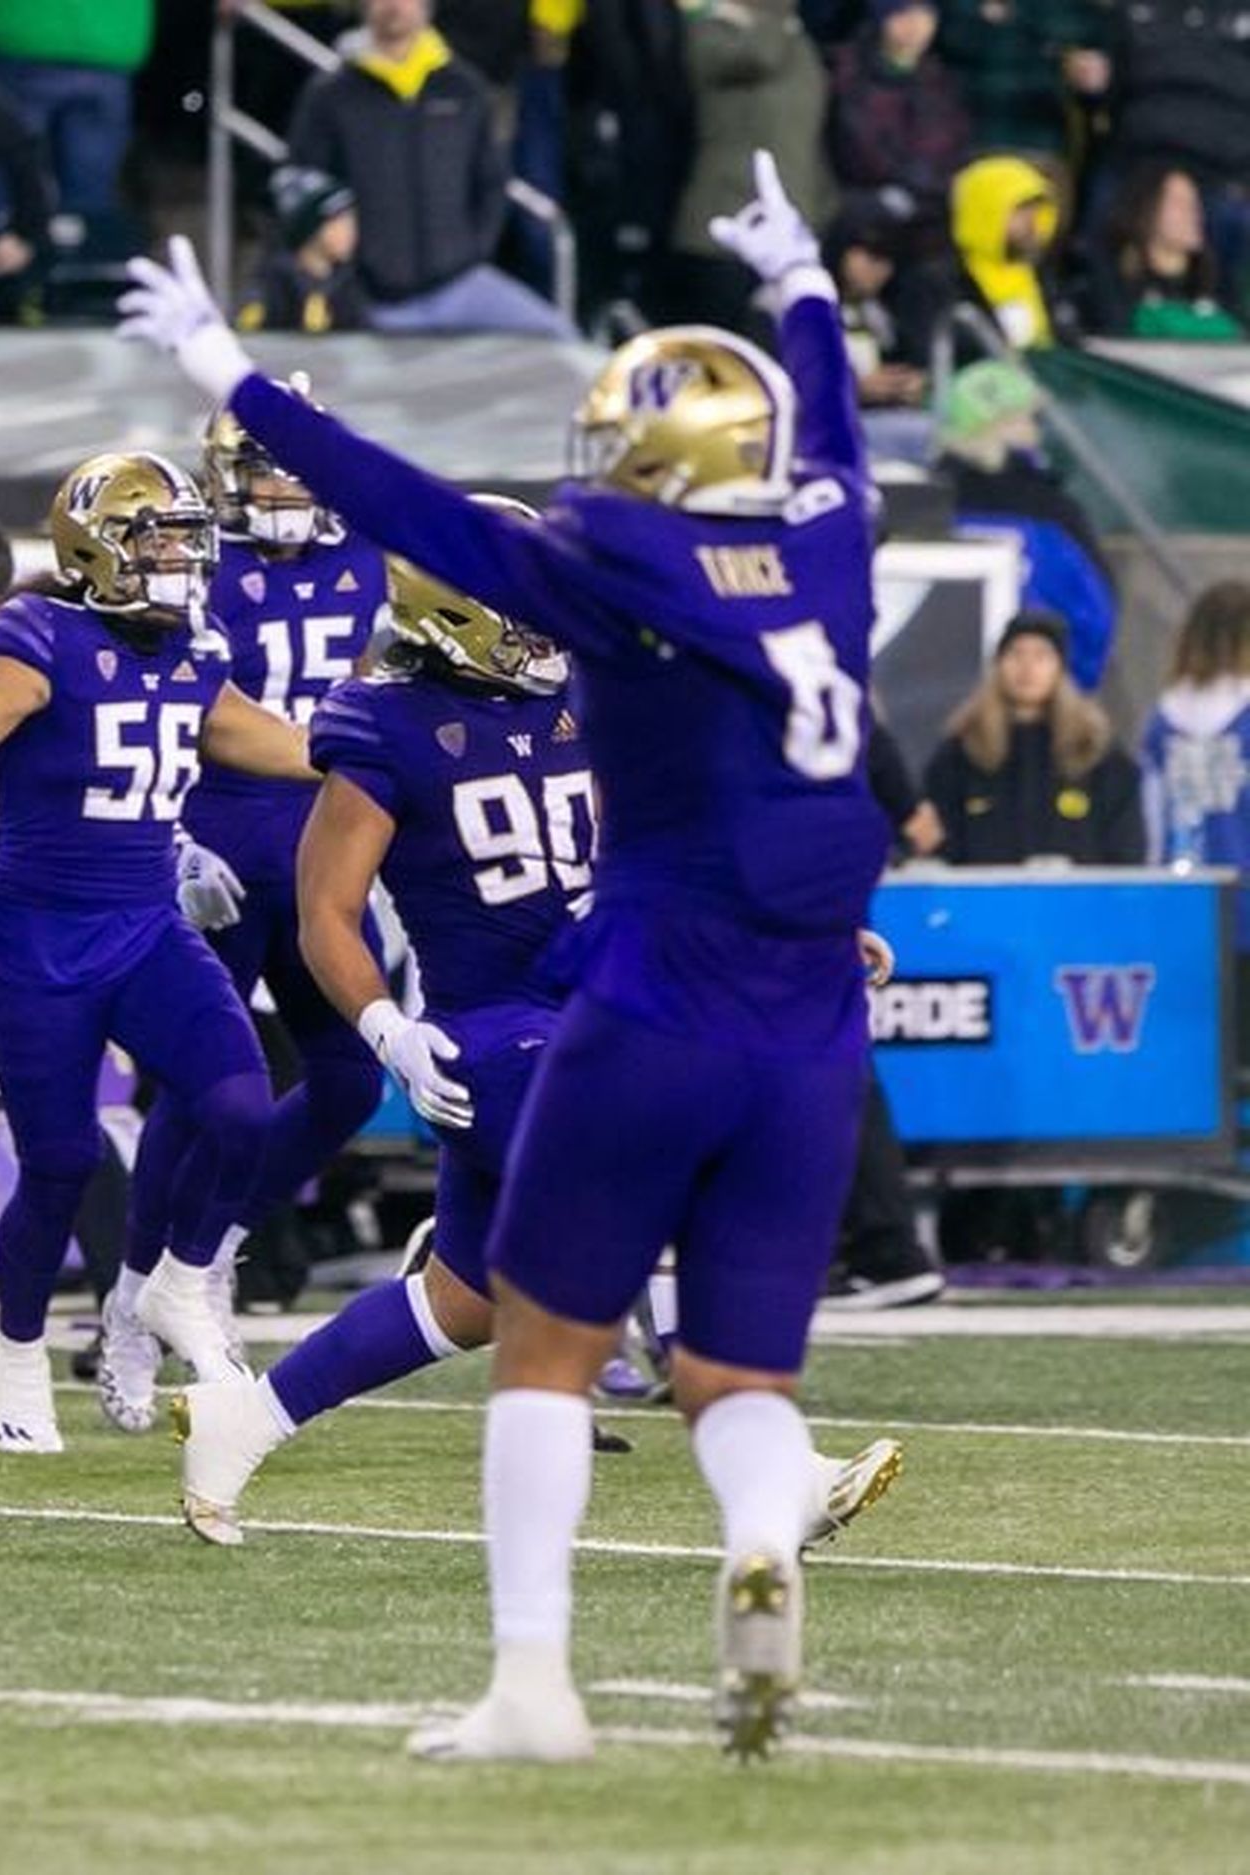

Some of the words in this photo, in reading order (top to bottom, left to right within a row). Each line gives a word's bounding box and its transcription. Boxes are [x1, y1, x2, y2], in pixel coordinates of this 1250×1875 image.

[68, 475, 111, 512] W
[257, 615, 355, 725] 15
[82, 701, 203, 822] 56
[507, 734, 533, 758] W
[453, 769, 599, 905] 90
[1055, 962, 1156, 1054] W
